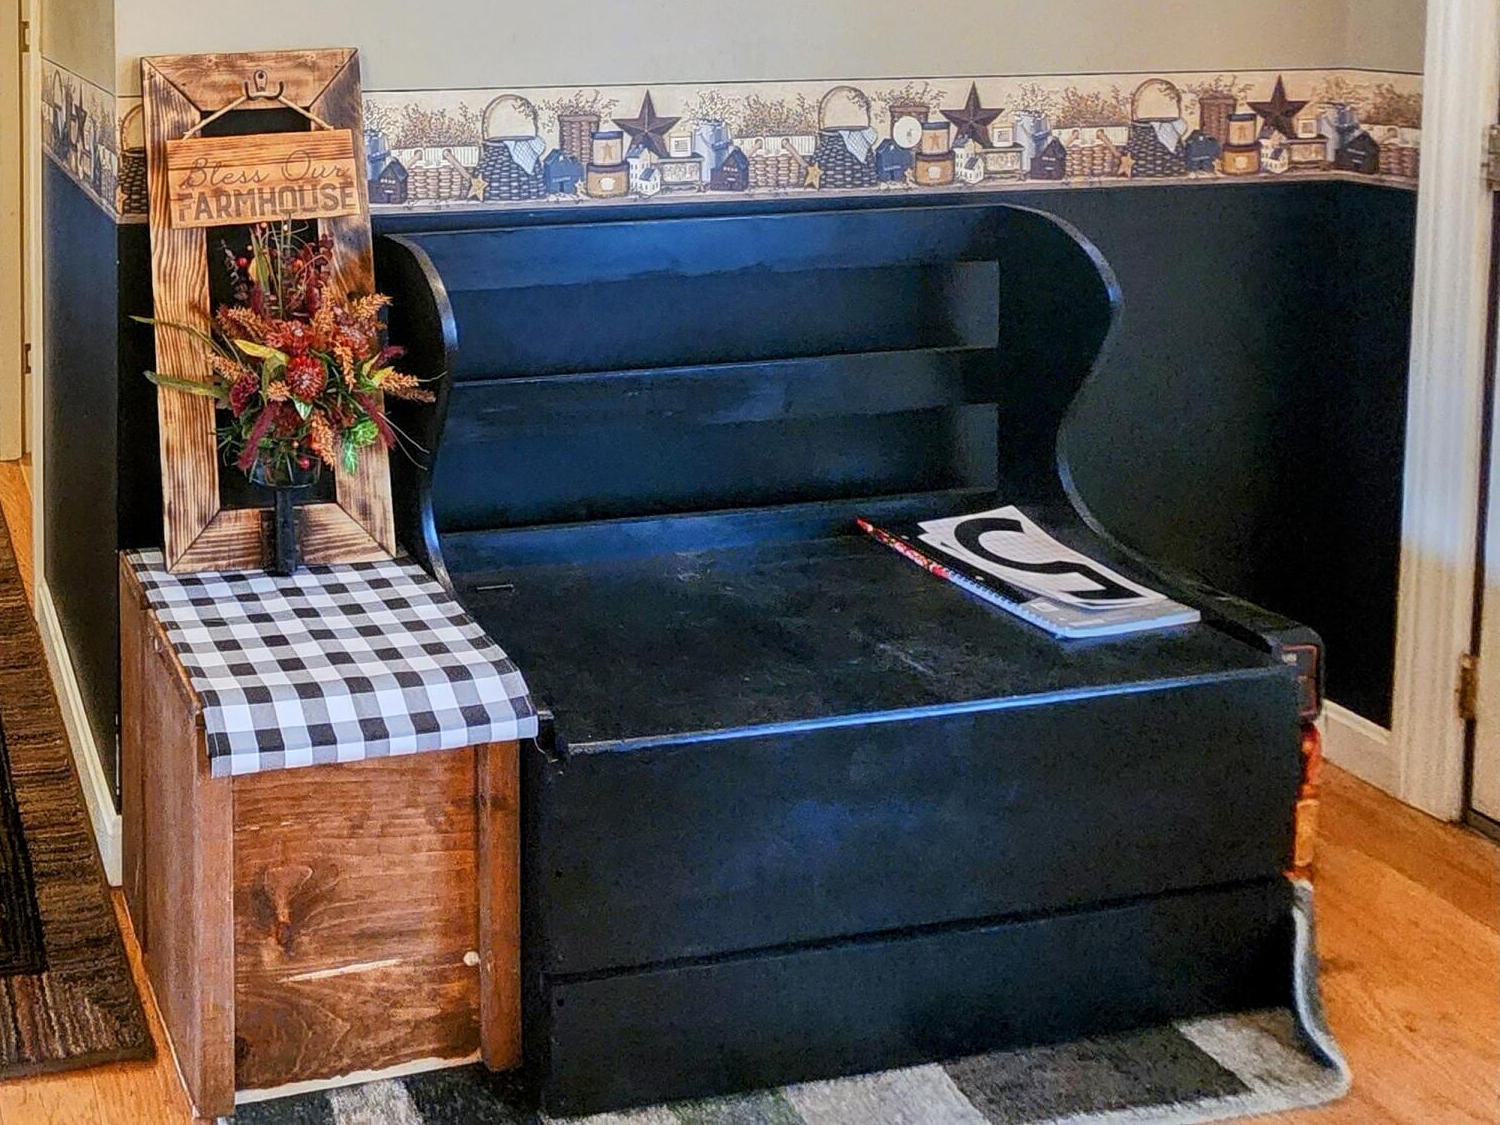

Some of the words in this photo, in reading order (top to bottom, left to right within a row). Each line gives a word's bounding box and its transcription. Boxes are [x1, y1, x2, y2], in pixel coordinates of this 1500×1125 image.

[179, 157, 270, 189] Bless
[281, 149, 351, 181] Our
[178, 181, 356, 222] FARMHOUSE
[954, 518, 1146, 600] S
